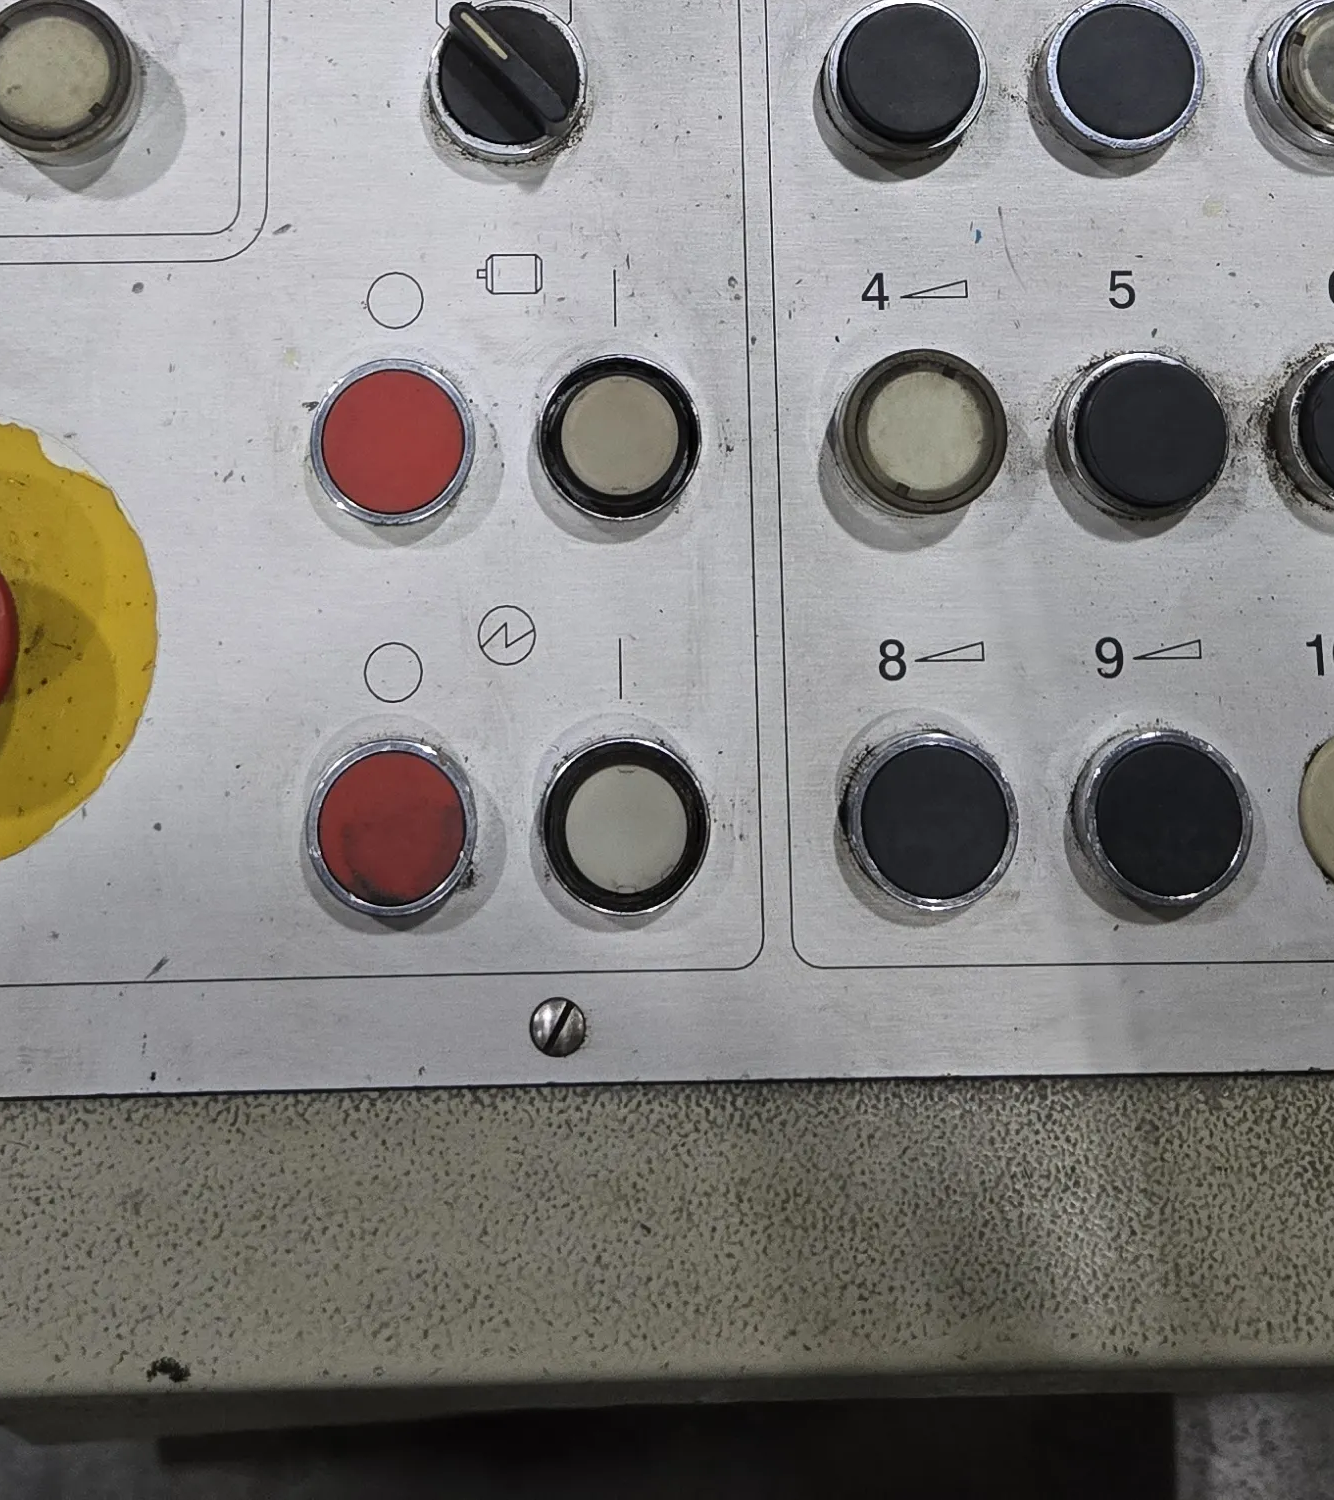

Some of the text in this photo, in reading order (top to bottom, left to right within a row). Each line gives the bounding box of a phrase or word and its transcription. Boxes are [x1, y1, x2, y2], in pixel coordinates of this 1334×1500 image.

[861, 272, 889, 311] 4
[1108, 270, 1136, 309] 5
[878, 639, 909, 681] 8
[1094, 636, 1125, 680] 9
